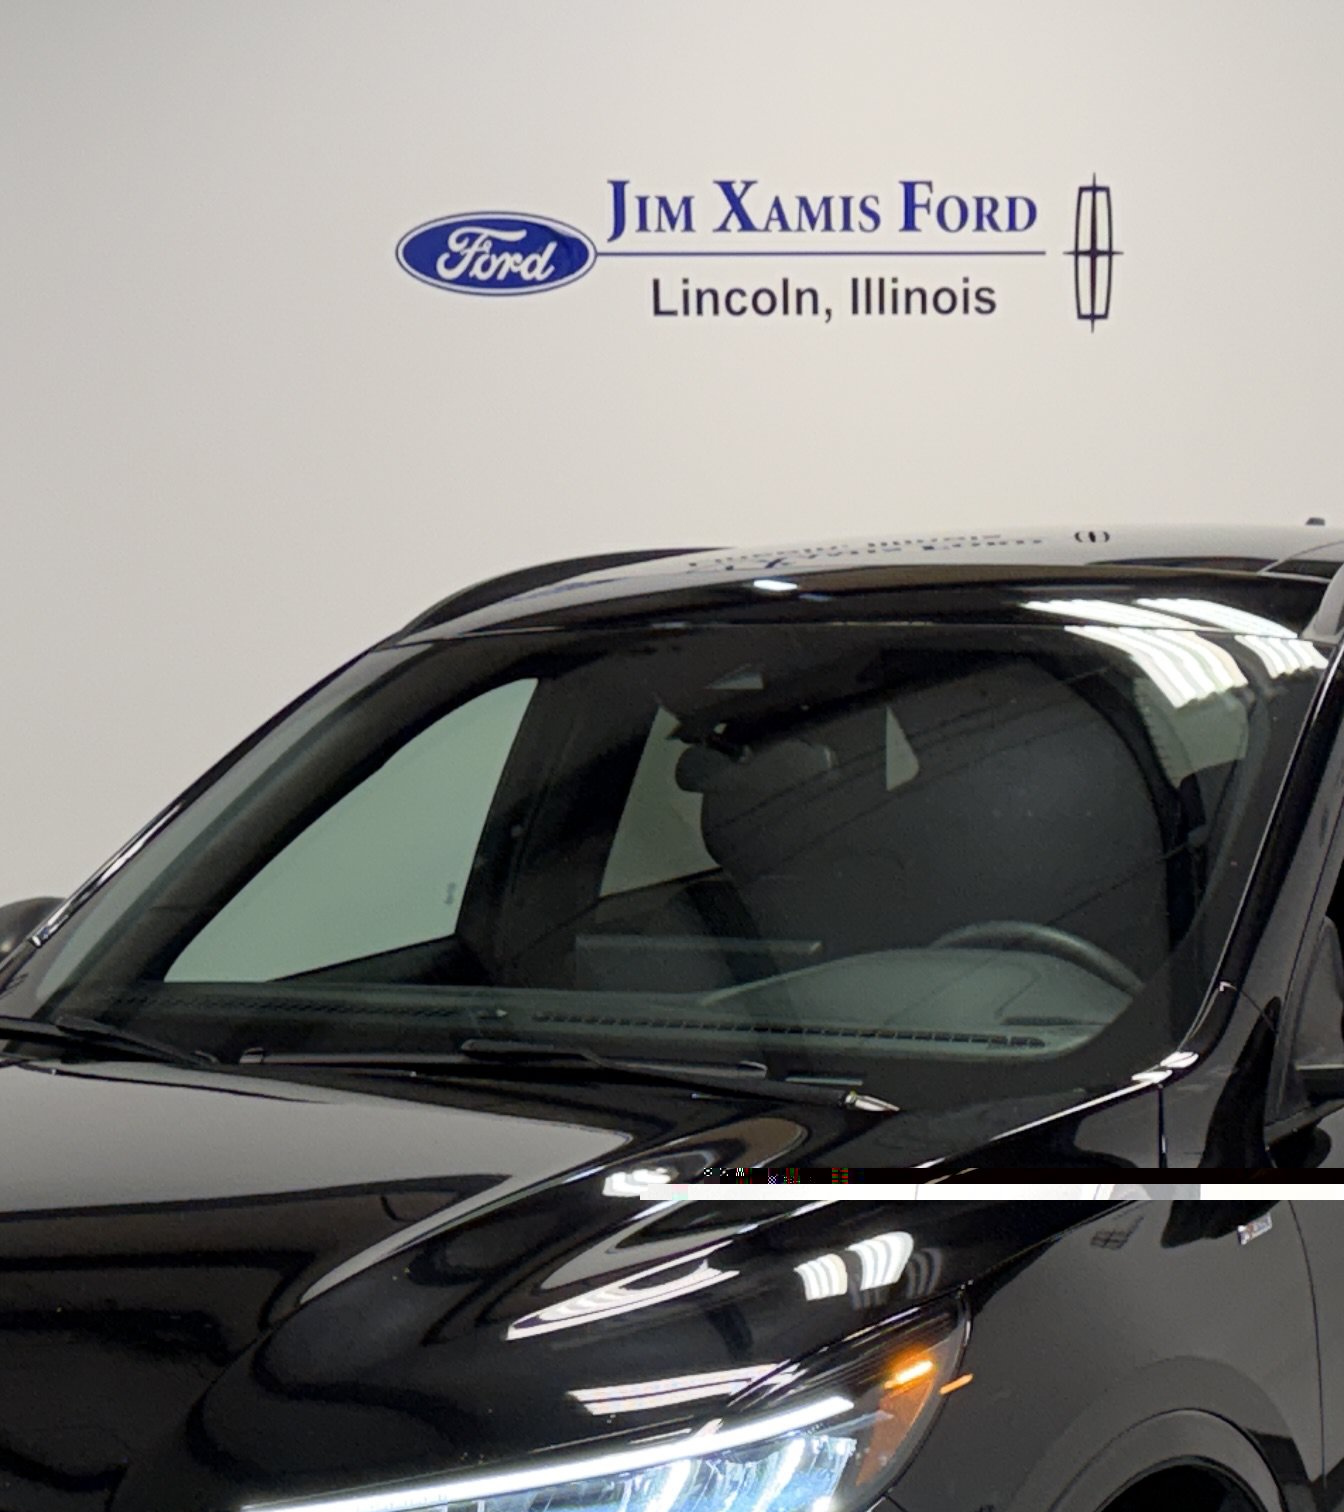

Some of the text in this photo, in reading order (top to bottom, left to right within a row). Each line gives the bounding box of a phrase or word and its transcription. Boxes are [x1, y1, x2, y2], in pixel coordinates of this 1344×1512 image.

[435, 227, 556, 283] Ford
[652, 277, 997, 323] Lincoln, Illinois
